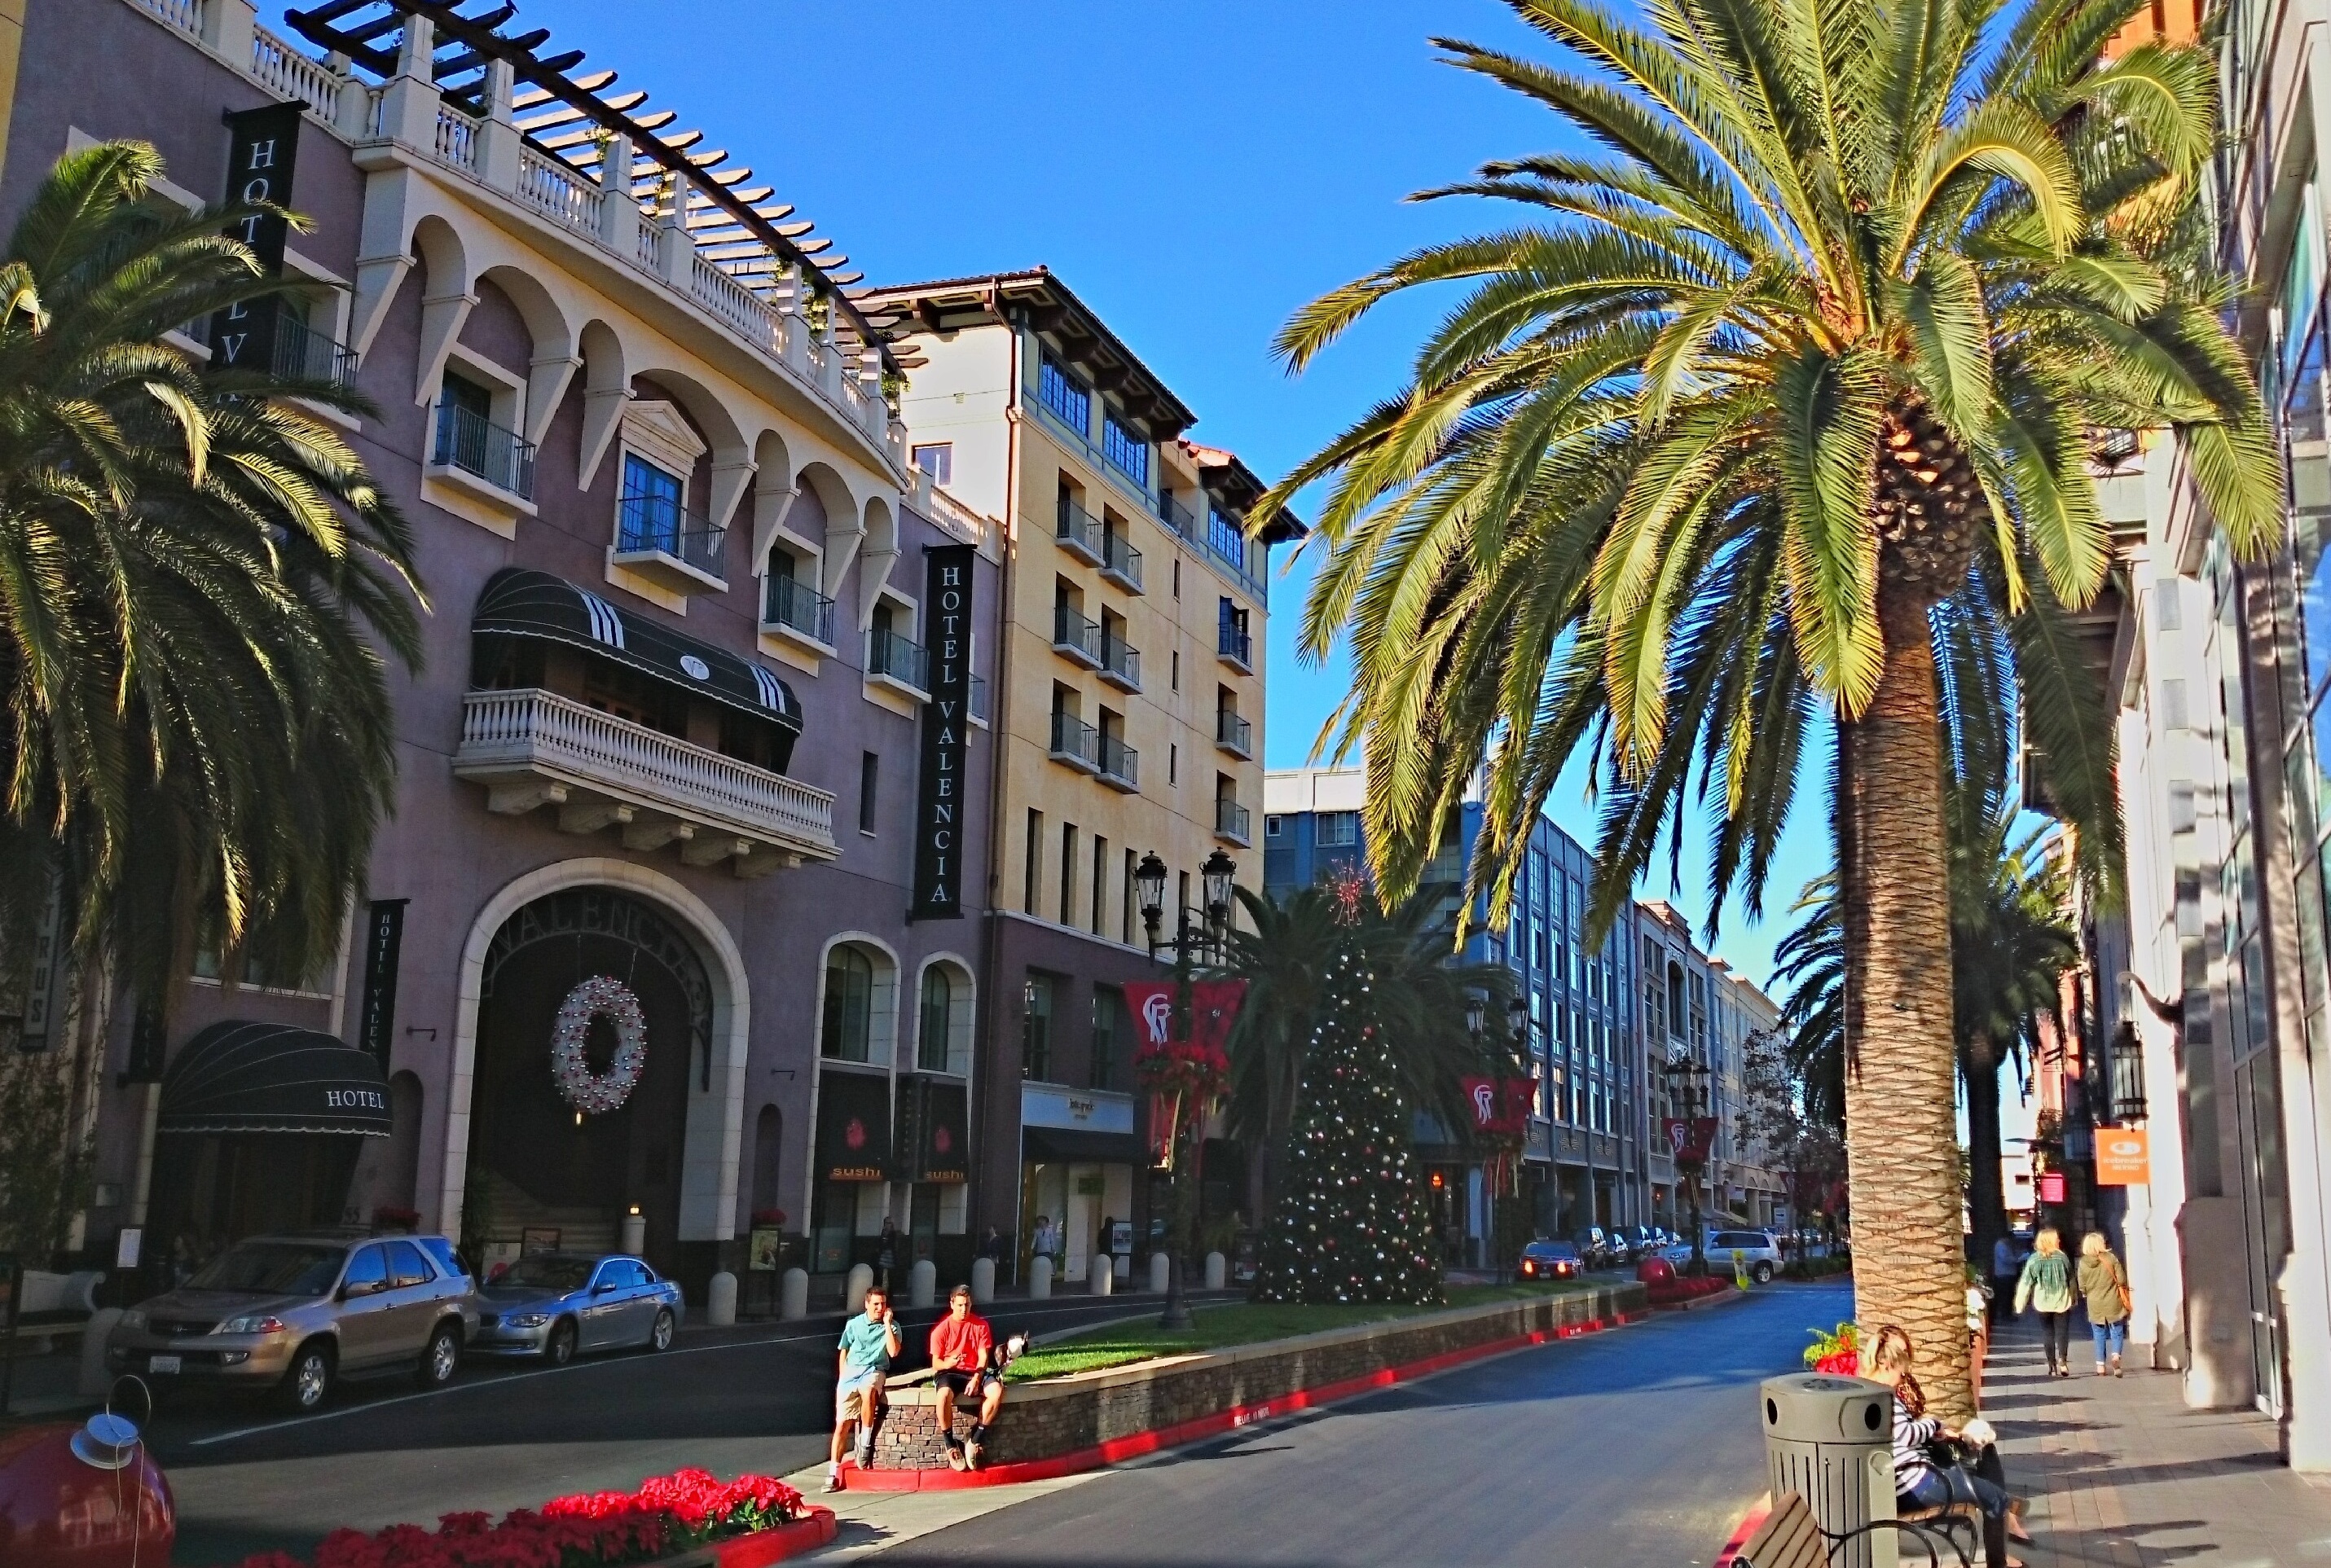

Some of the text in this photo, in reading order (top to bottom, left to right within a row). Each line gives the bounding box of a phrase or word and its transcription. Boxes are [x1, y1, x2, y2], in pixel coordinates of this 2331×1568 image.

[229, 139, 275, 319] HOTL
[930, 567, 961, 903] HOTEL VALENCIA
[369, 987, 383, 1051] VALEN
[326, 1090, 385, 1109] HOTEL
[833, 1166, 882, 1177] sushi
[926, 1170, 965, 1179] sushi
